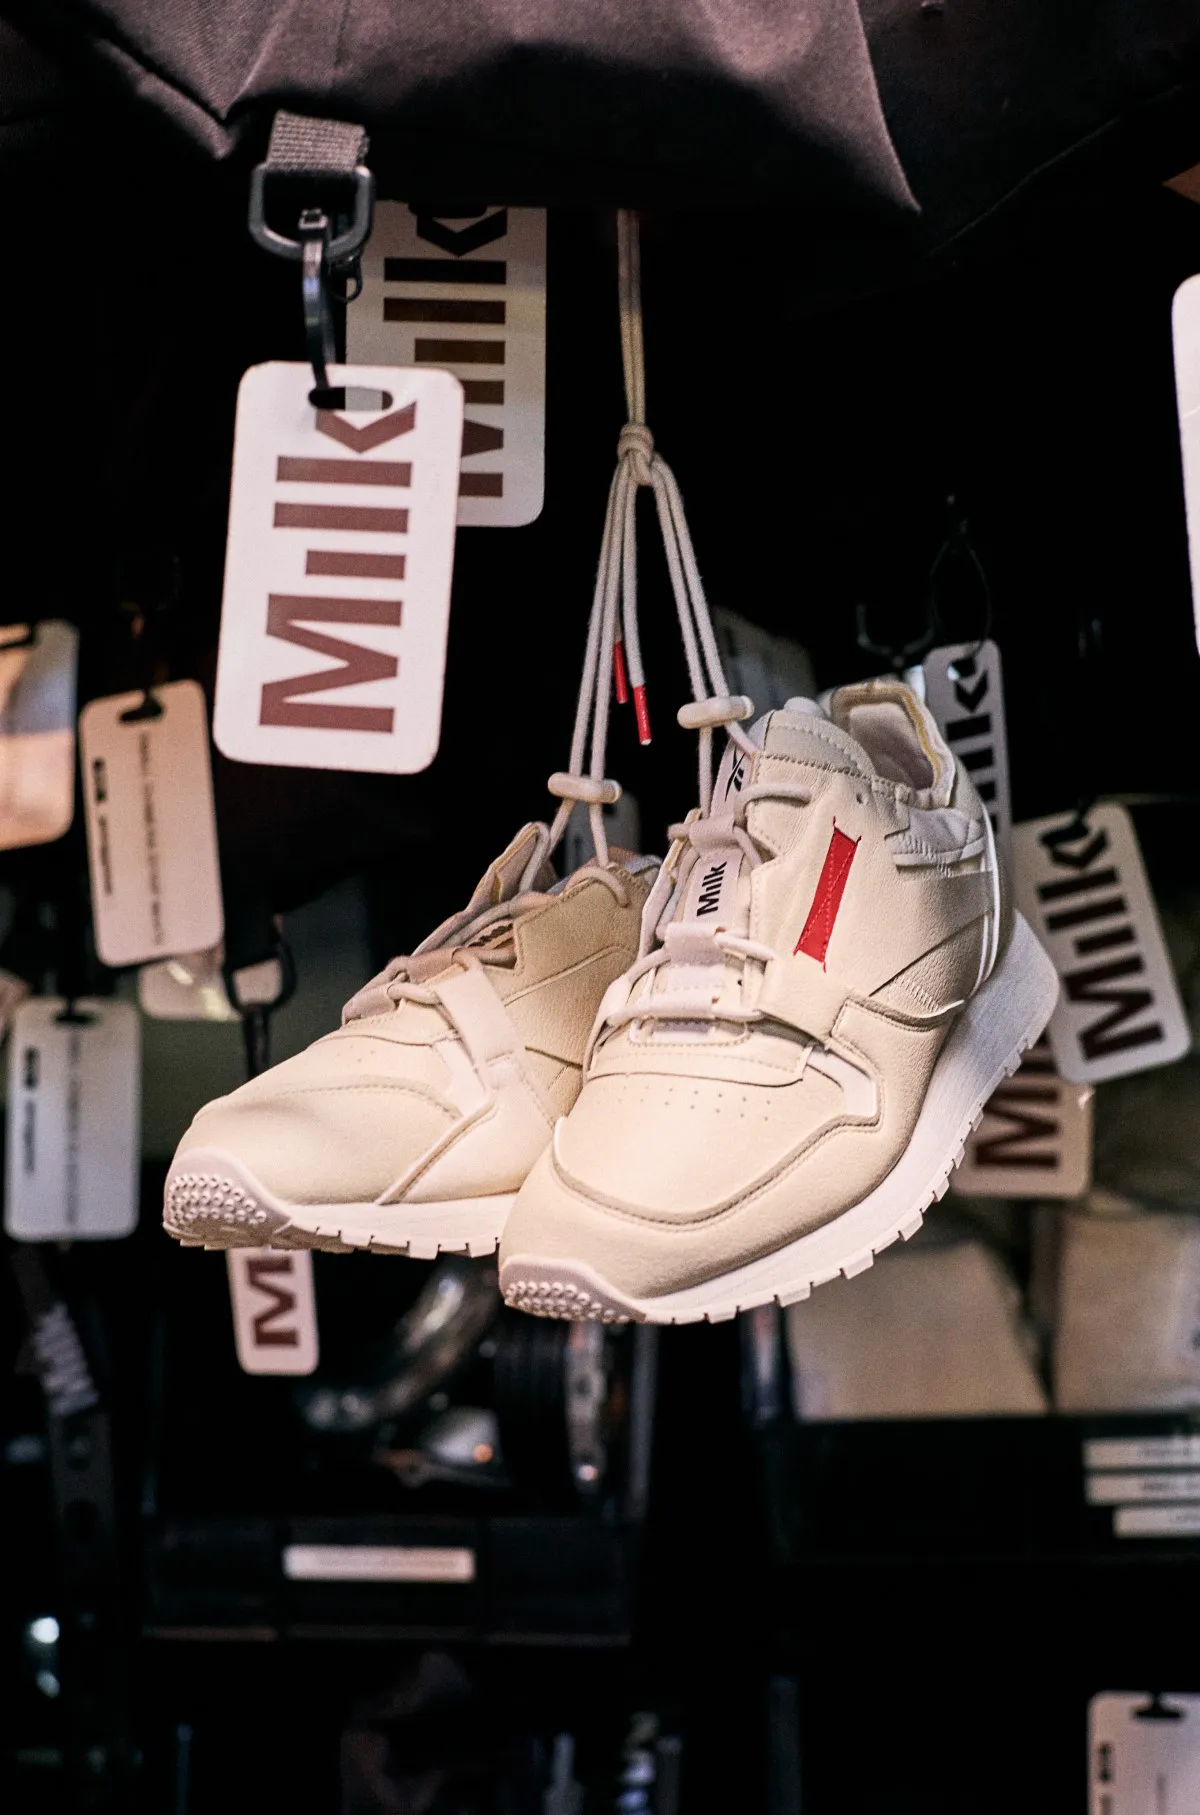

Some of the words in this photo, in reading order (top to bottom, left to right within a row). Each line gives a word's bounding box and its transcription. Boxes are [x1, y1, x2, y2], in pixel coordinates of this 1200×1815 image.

[259, 401, 416, 733] Milk
[697, 861, 727, 916] Milk
[1037, 828, 1165, 1062] Milk
